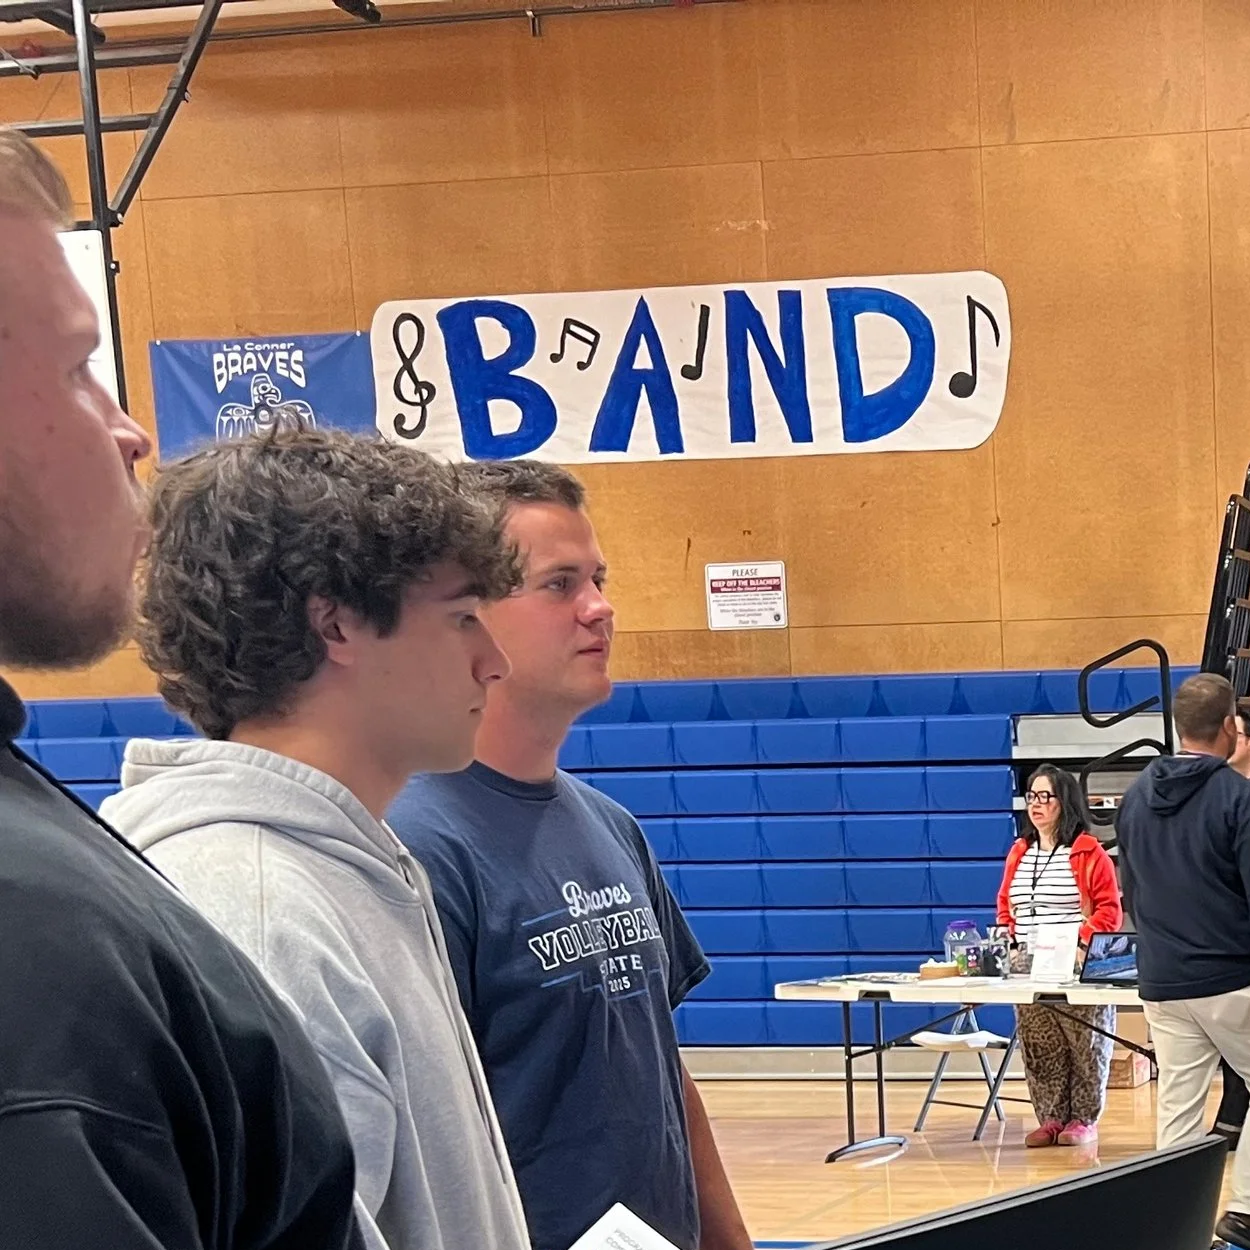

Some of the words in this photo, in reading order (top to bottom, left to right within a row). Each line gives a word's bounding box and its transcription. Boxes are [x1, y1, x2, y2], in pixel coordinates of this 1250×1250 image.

[244, 342, 294, 351] Conner
[212, 350, 306, 394] BRAVES
[436, 286, 937, 461] BAND
[711, 580, 726, 588] KEEP
[726, 579, 737, 587] OFF
[738, 579, 748, 587] THE
[749, 578, 780, 586] BLEACHERS
[732, 568, 758, 577] PLEASE
[562, 881, 631, 917] Braves
[528, 907, 661, 970] VOLLEYBAL
